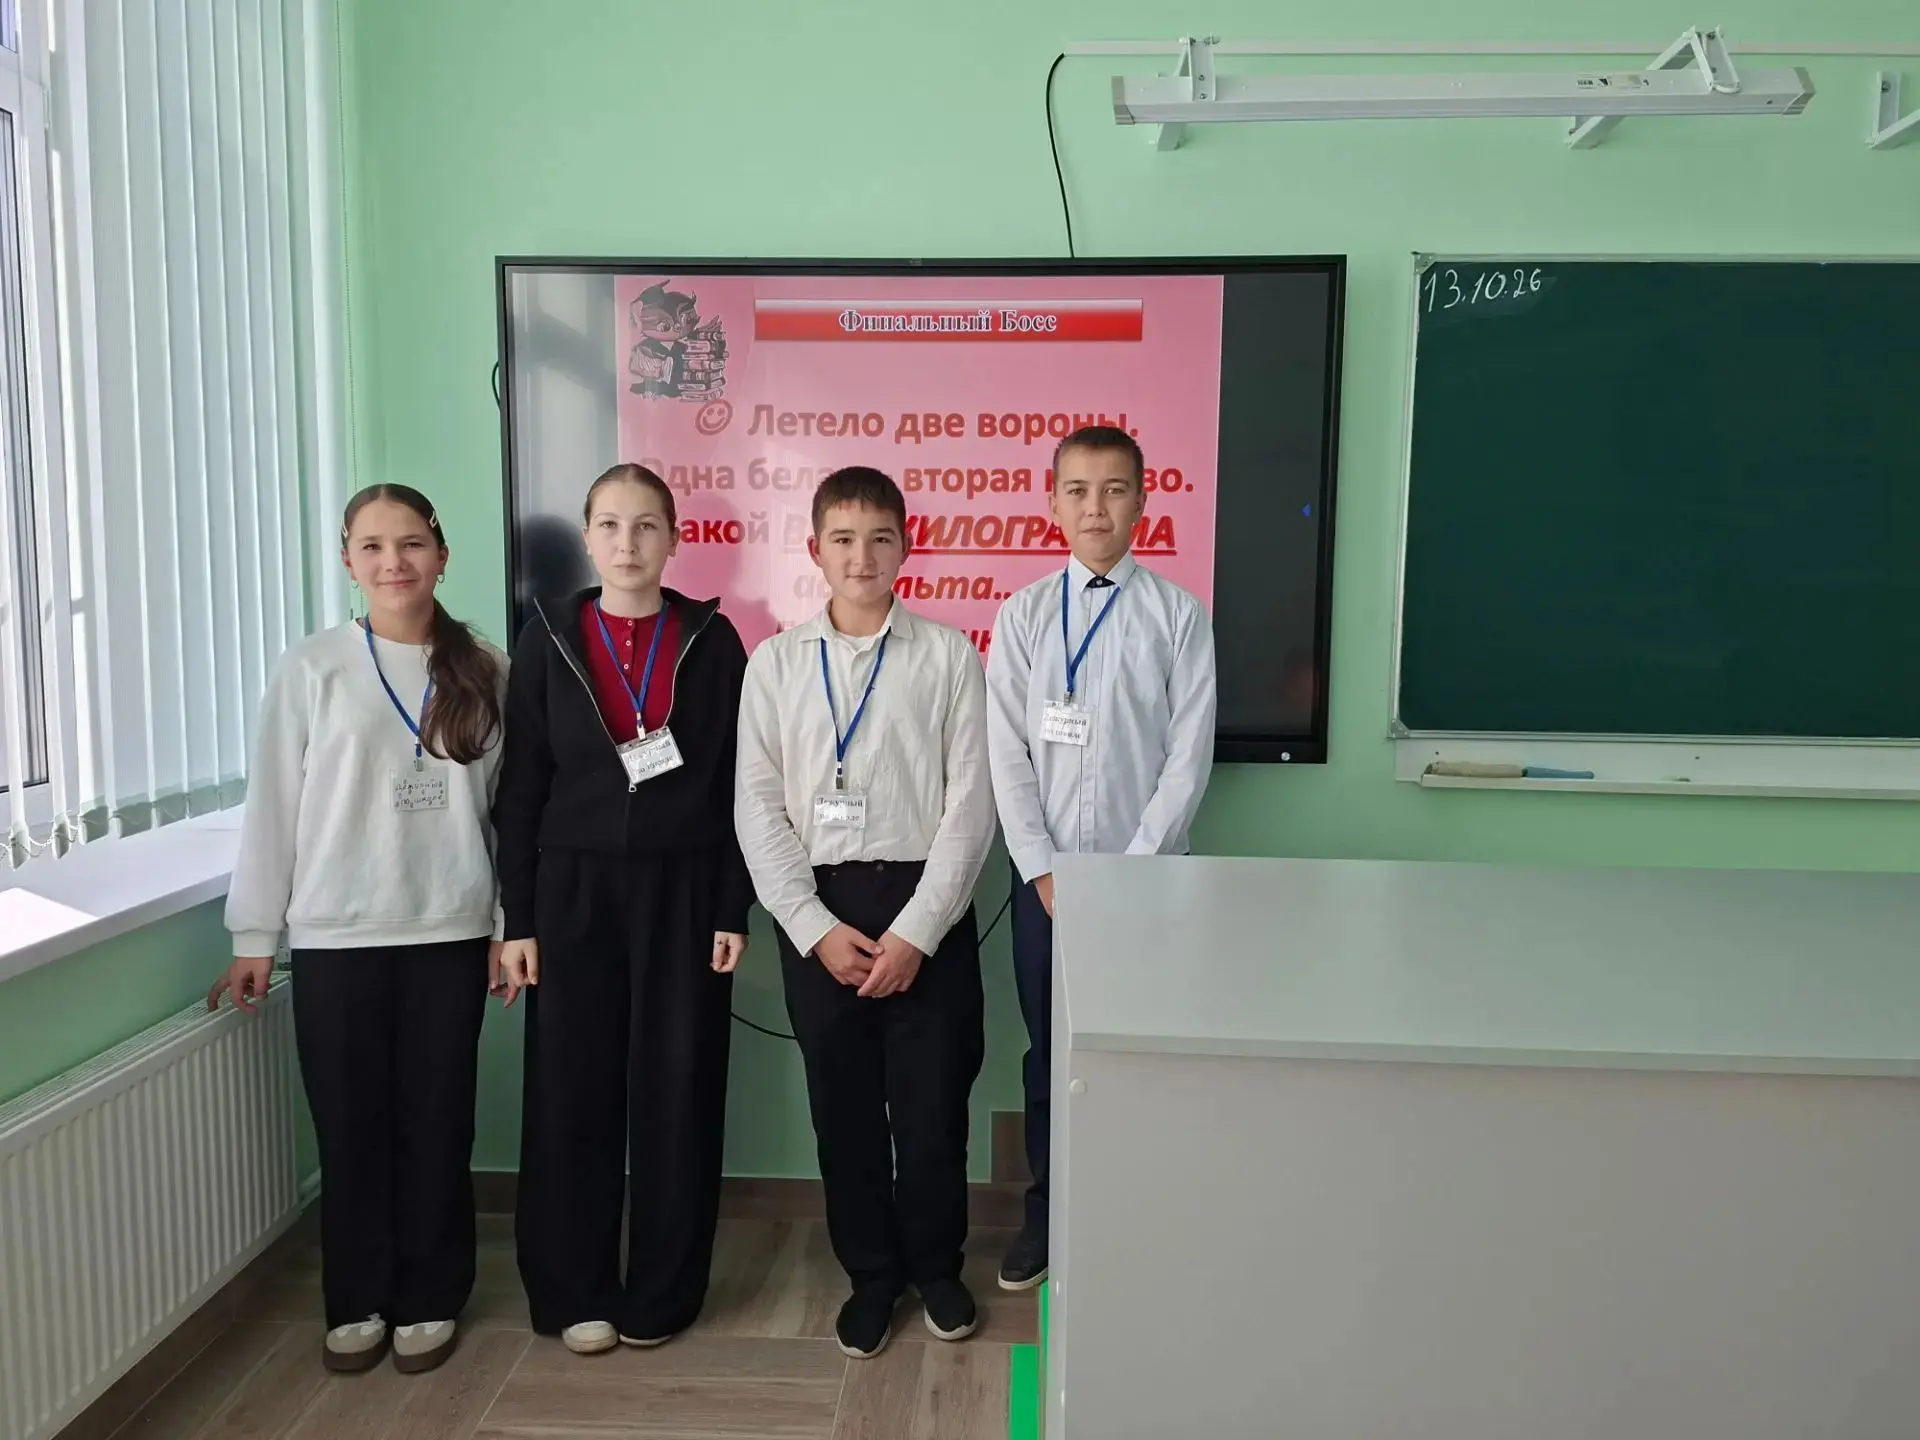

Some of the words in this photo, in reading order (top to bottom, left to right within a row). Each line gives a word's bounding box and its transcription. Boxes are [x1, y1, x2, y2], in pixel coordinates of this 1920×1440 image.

[1424, 268, 1541, 312] 13.10.26
[839, 309, 992, 331] Финальный
[999, 309, 1057, 331] Босс
[747, 404, 885, 437] Летело
[894, 412, 965, 444] две
[903, 467, 1031, 499] вторая
[680, 511, 770, 545] акой
